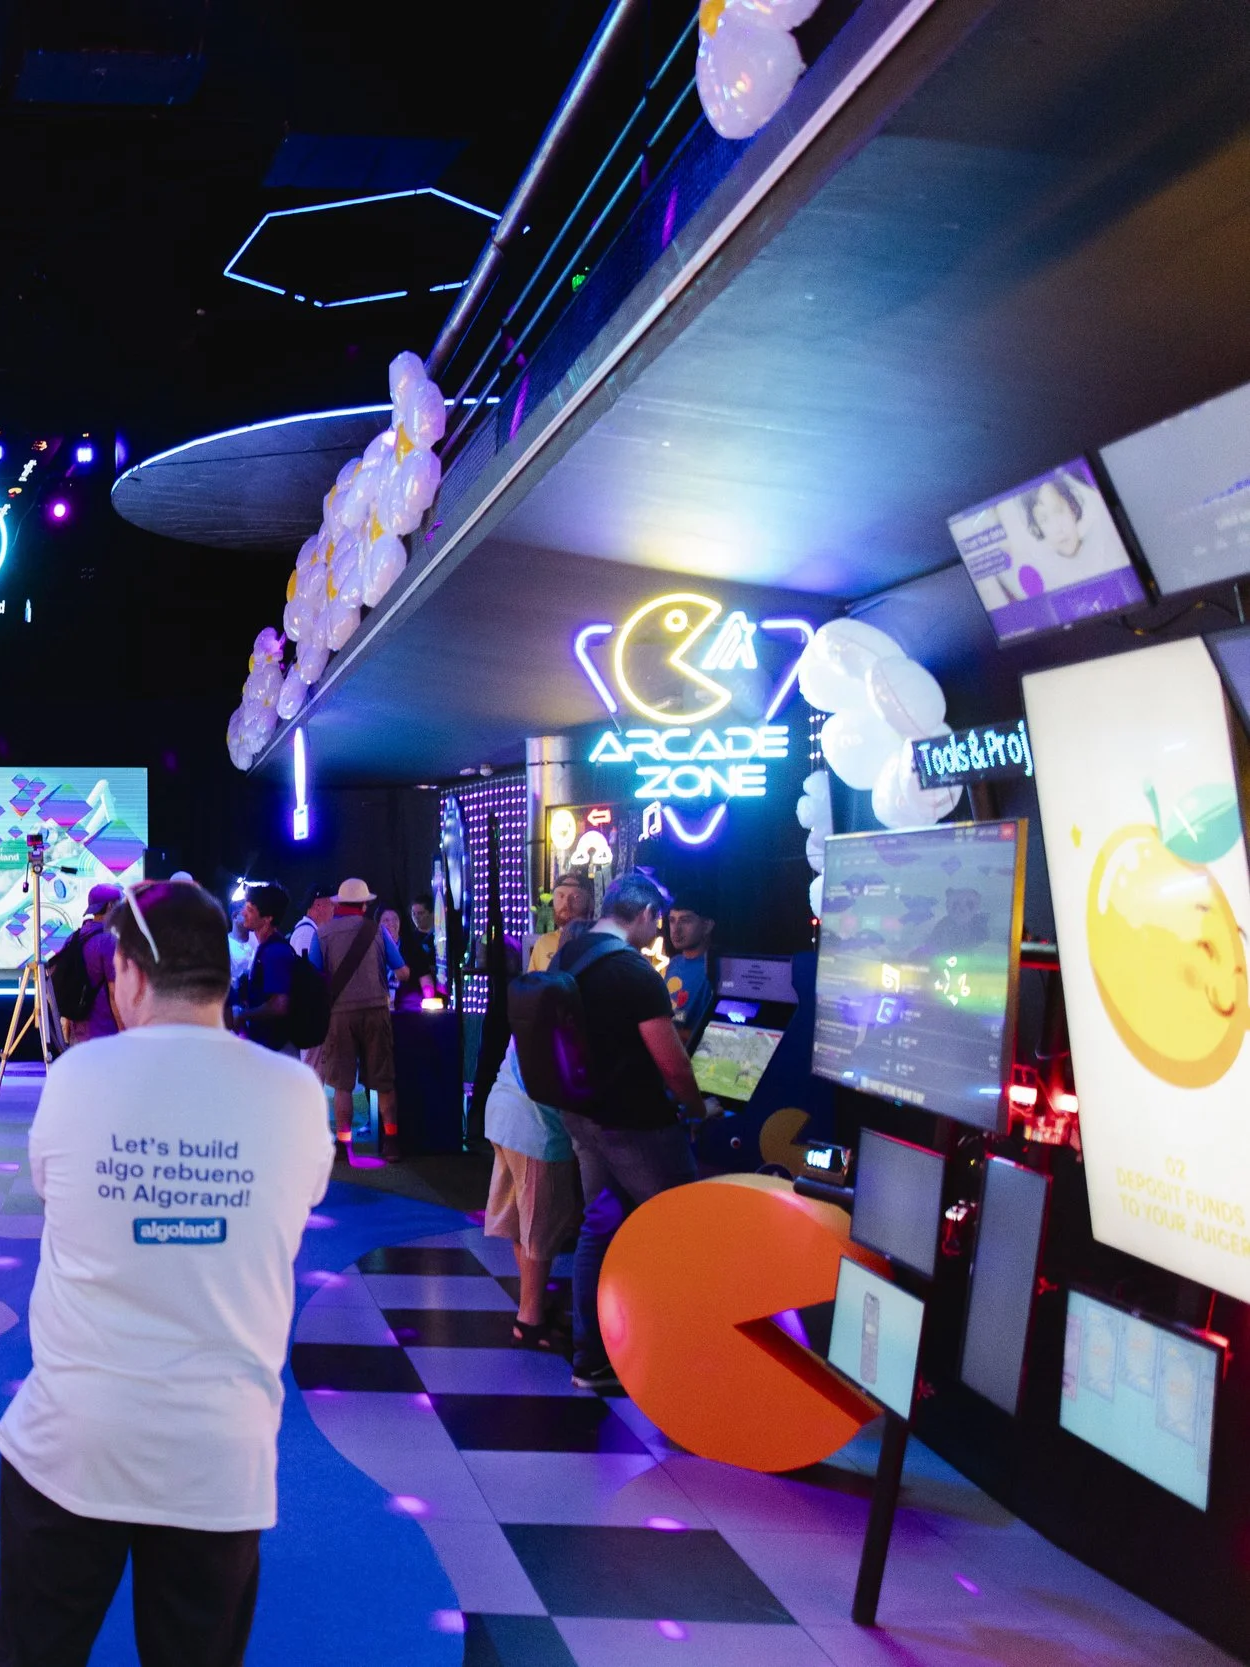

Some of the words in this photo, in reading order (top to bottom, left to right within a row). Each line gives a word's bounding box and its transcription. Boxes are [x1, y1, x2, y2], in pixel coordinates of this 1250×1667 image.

[588, 726, 789, 763] ARCADE
[634, 764, 766, 798] ZONE
[111, 1134, 169, 1156] Let's
[179, 1139, 238, 1160] build
[95, 1158, 145, 1182] algo
[153, 1163, 254, 1184] rebueno
[97, 1184, 126, 1200] on
[133, 1184, 251, 1209] Algorand!
[1116, 1167, 1181, 1206] DEPOSIT
[1185, 1189, 1246, 1227] FUNDS
[1119, 1192, 1140, 1218] TO
[1144, 1204, 1187, 1235] YOUR
[139, 1221, 222, 1242] algoland
